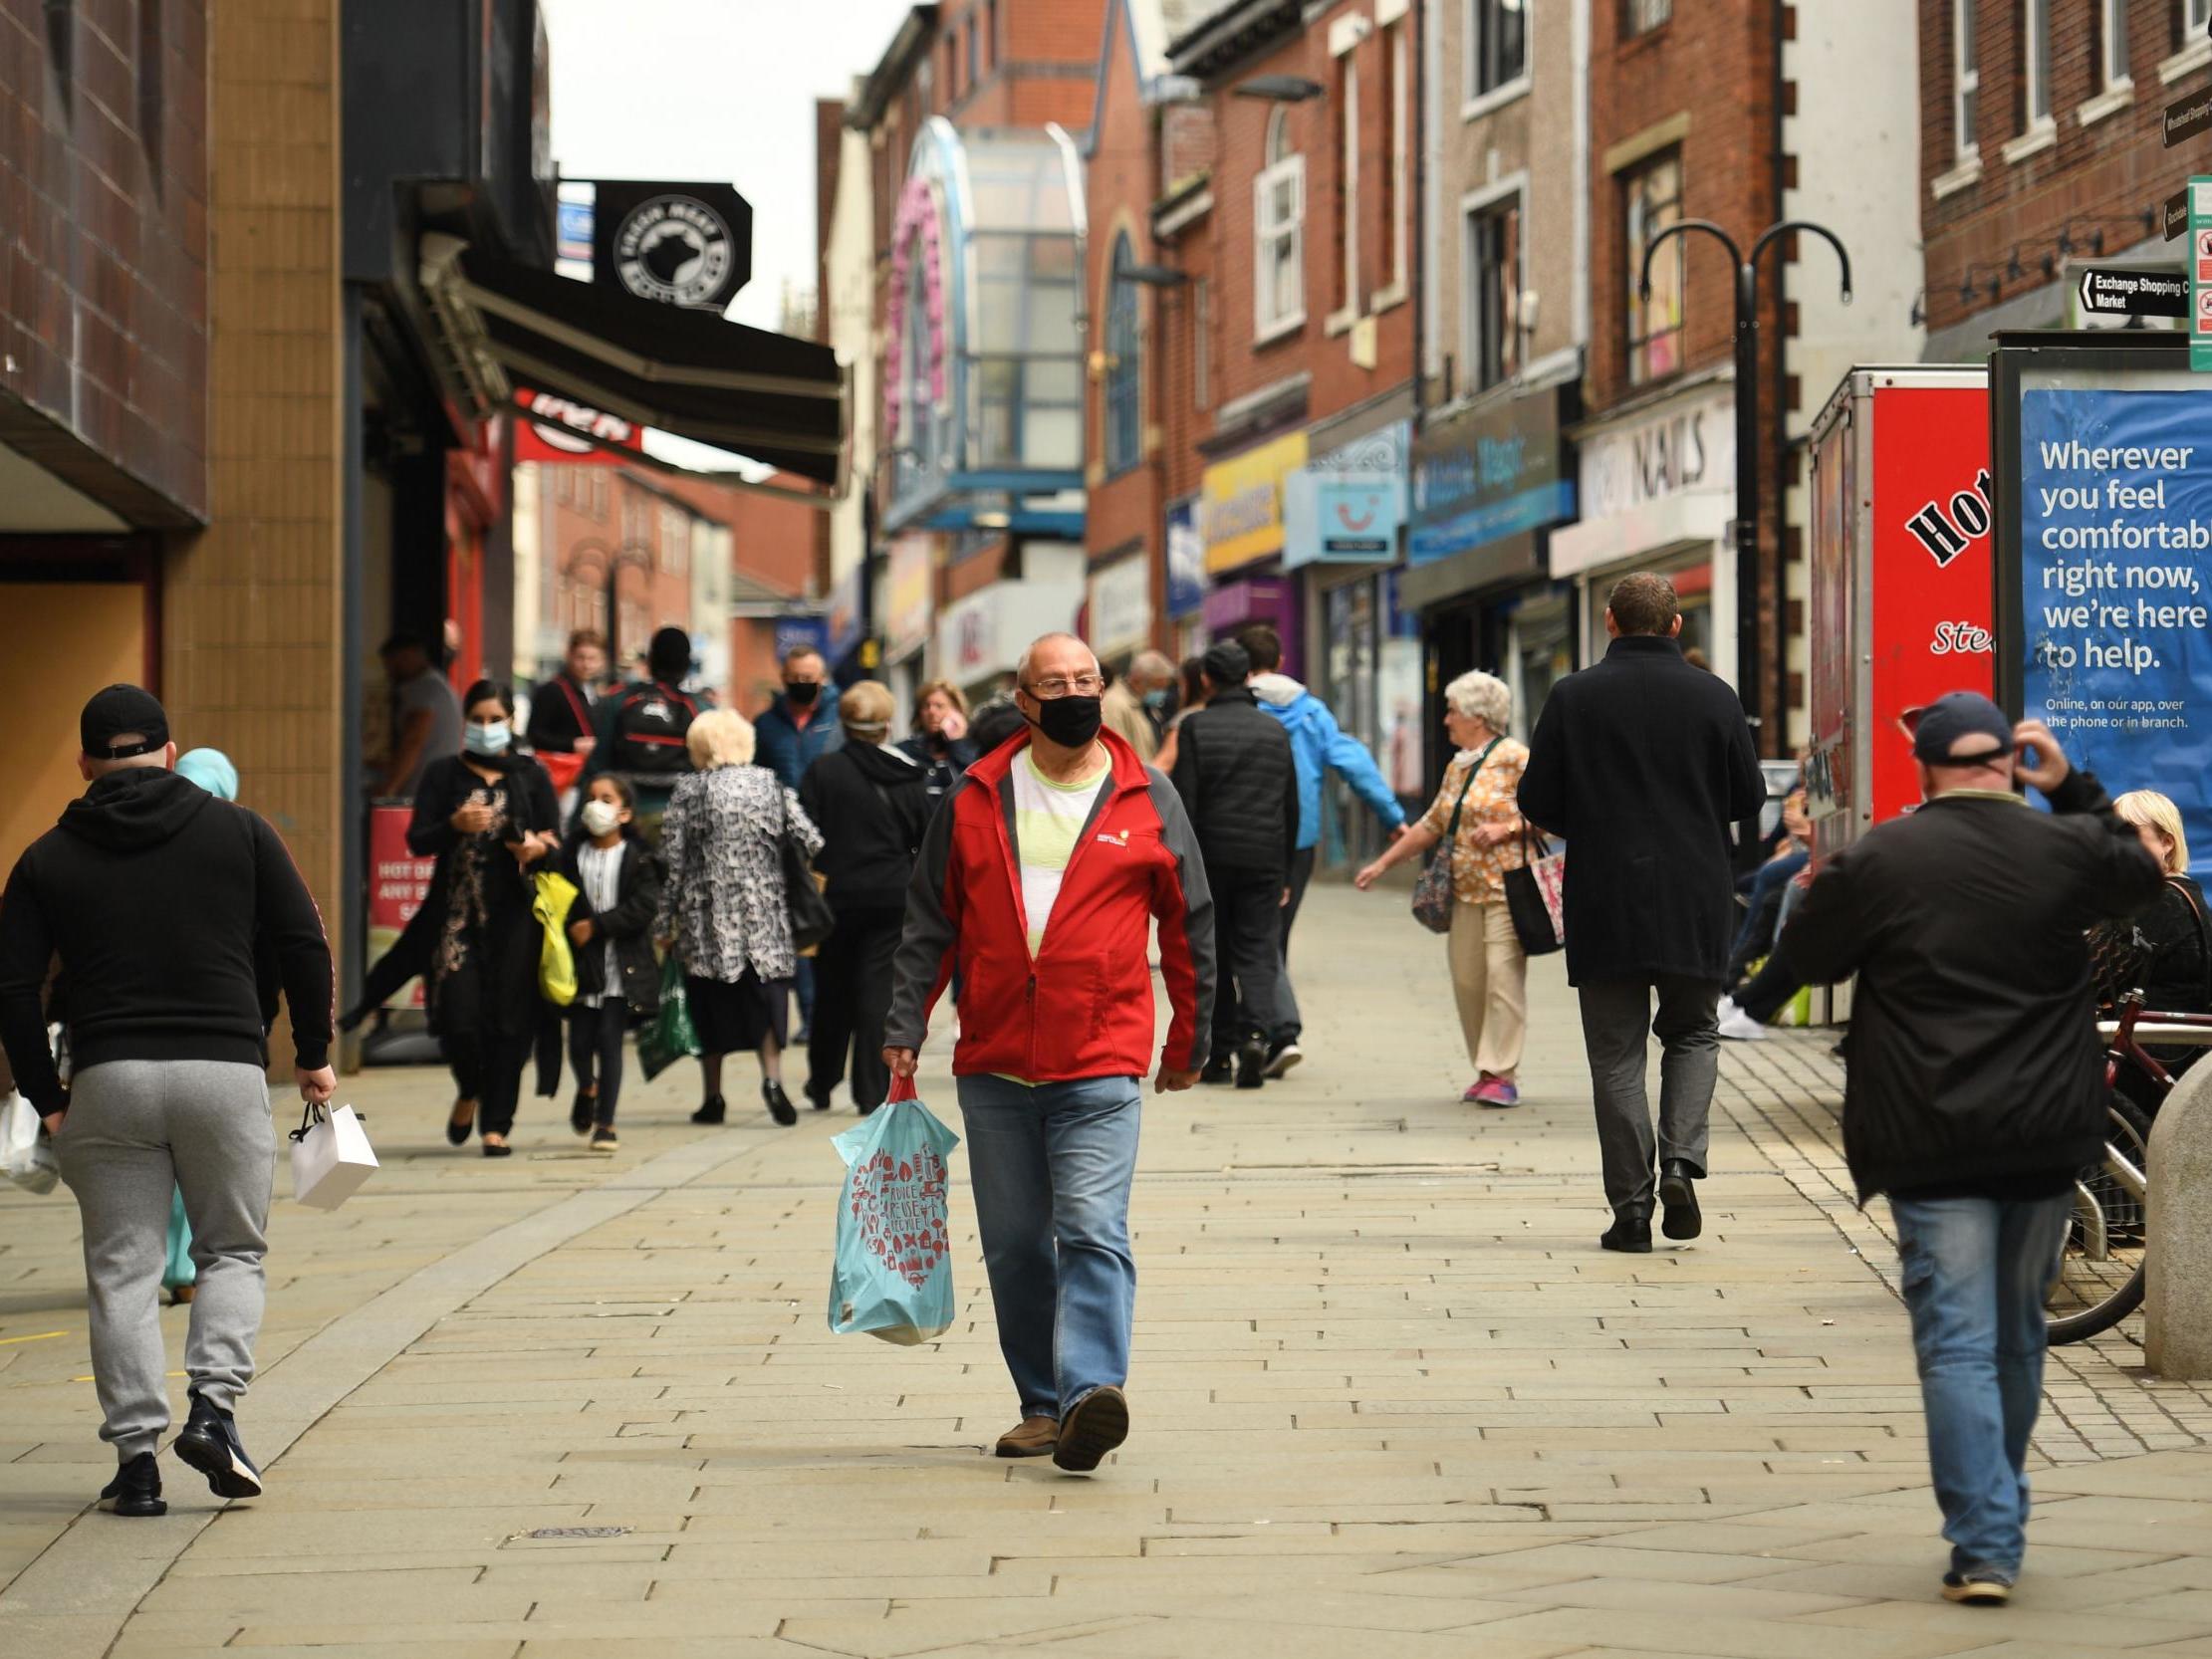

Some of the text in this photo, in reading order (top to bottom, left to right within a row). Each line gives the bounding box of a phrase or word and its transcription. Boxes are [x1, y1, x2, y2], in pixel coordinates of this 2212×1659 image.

[2095, 275, 2138, 294] Exchange
[2139, 277, 2181, 297] Shopping
[2095, 294, 2126, 309] Market
[2041, 440, 2193, 470] Wherever
[2041, 479, 2165, 517] you feel
[2043, 559, 2199, 596] right now,
[2137, 598, 2207, 628] here
[2045, 638, 2160, 674] to help.
[2046, 698, 2184, 713] Online, on our app, over
[2047, 716, 2188, 730] the phone or in branch.
